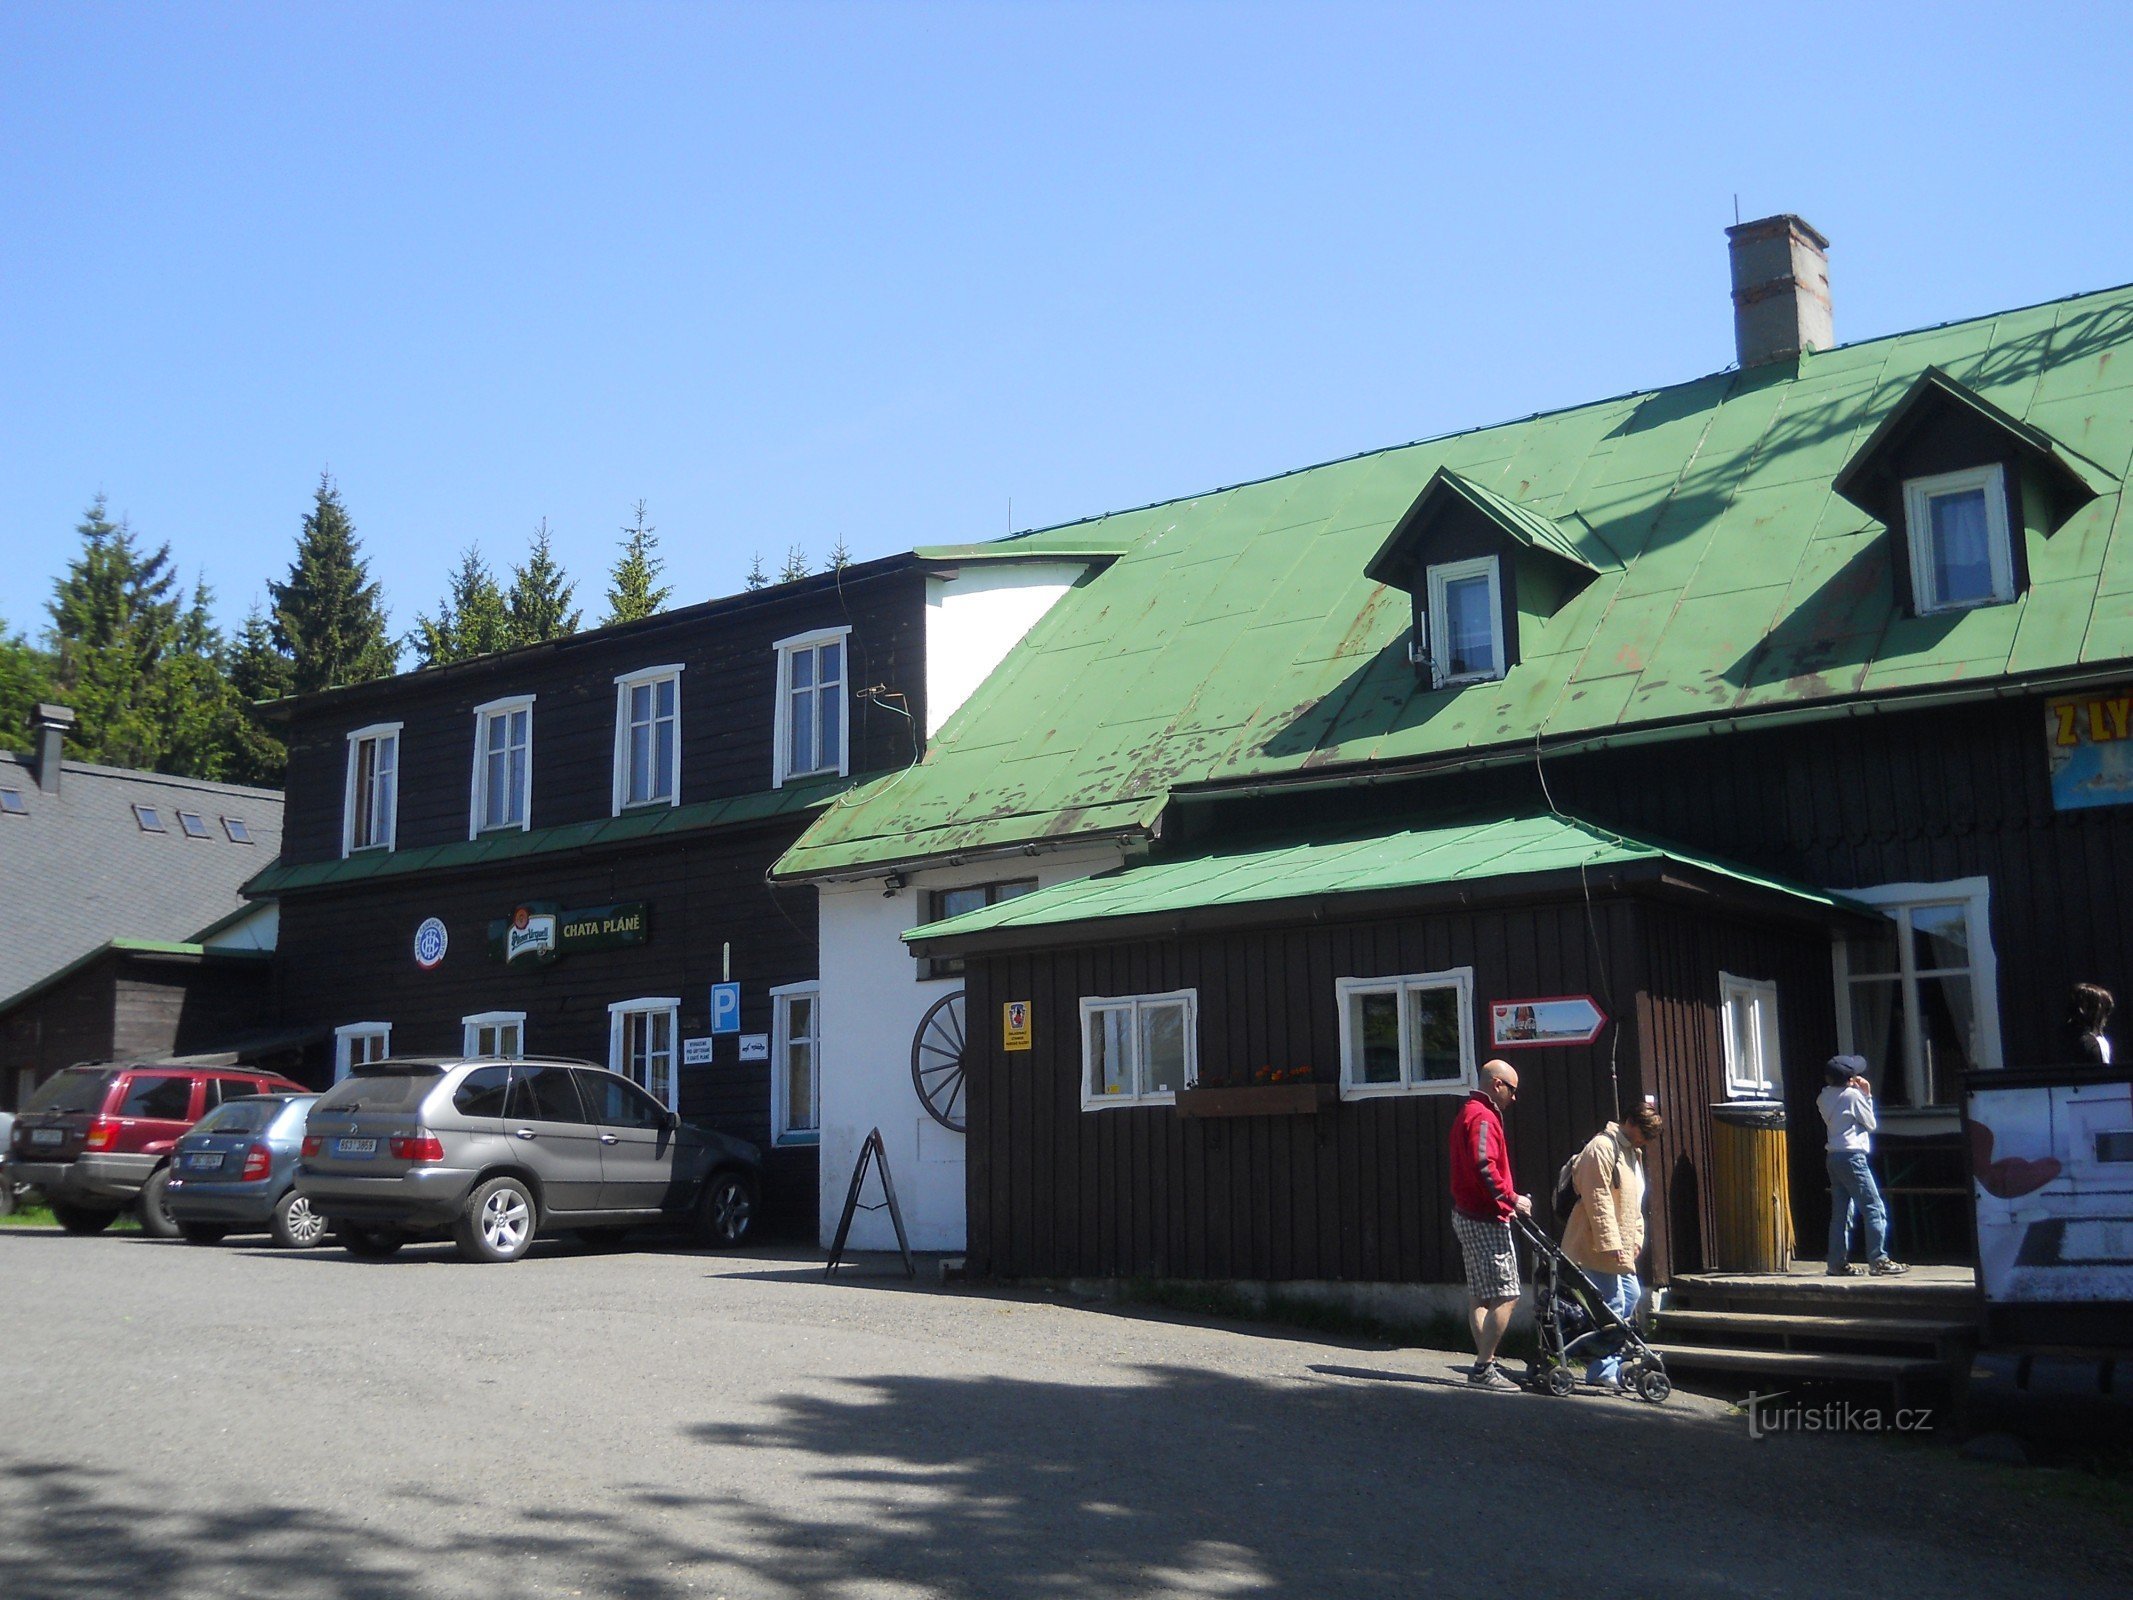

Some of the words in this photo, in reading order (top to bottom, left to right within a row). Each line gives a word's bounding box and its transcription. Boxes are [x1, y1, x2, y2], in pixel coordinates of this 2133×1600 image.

[2087, 698, 2132, 743] LY
[563, 921, 599, 938] CHATA
[603, 914, 640, 933] PLÁNĚ
[714, 988, 736, 1029] P
